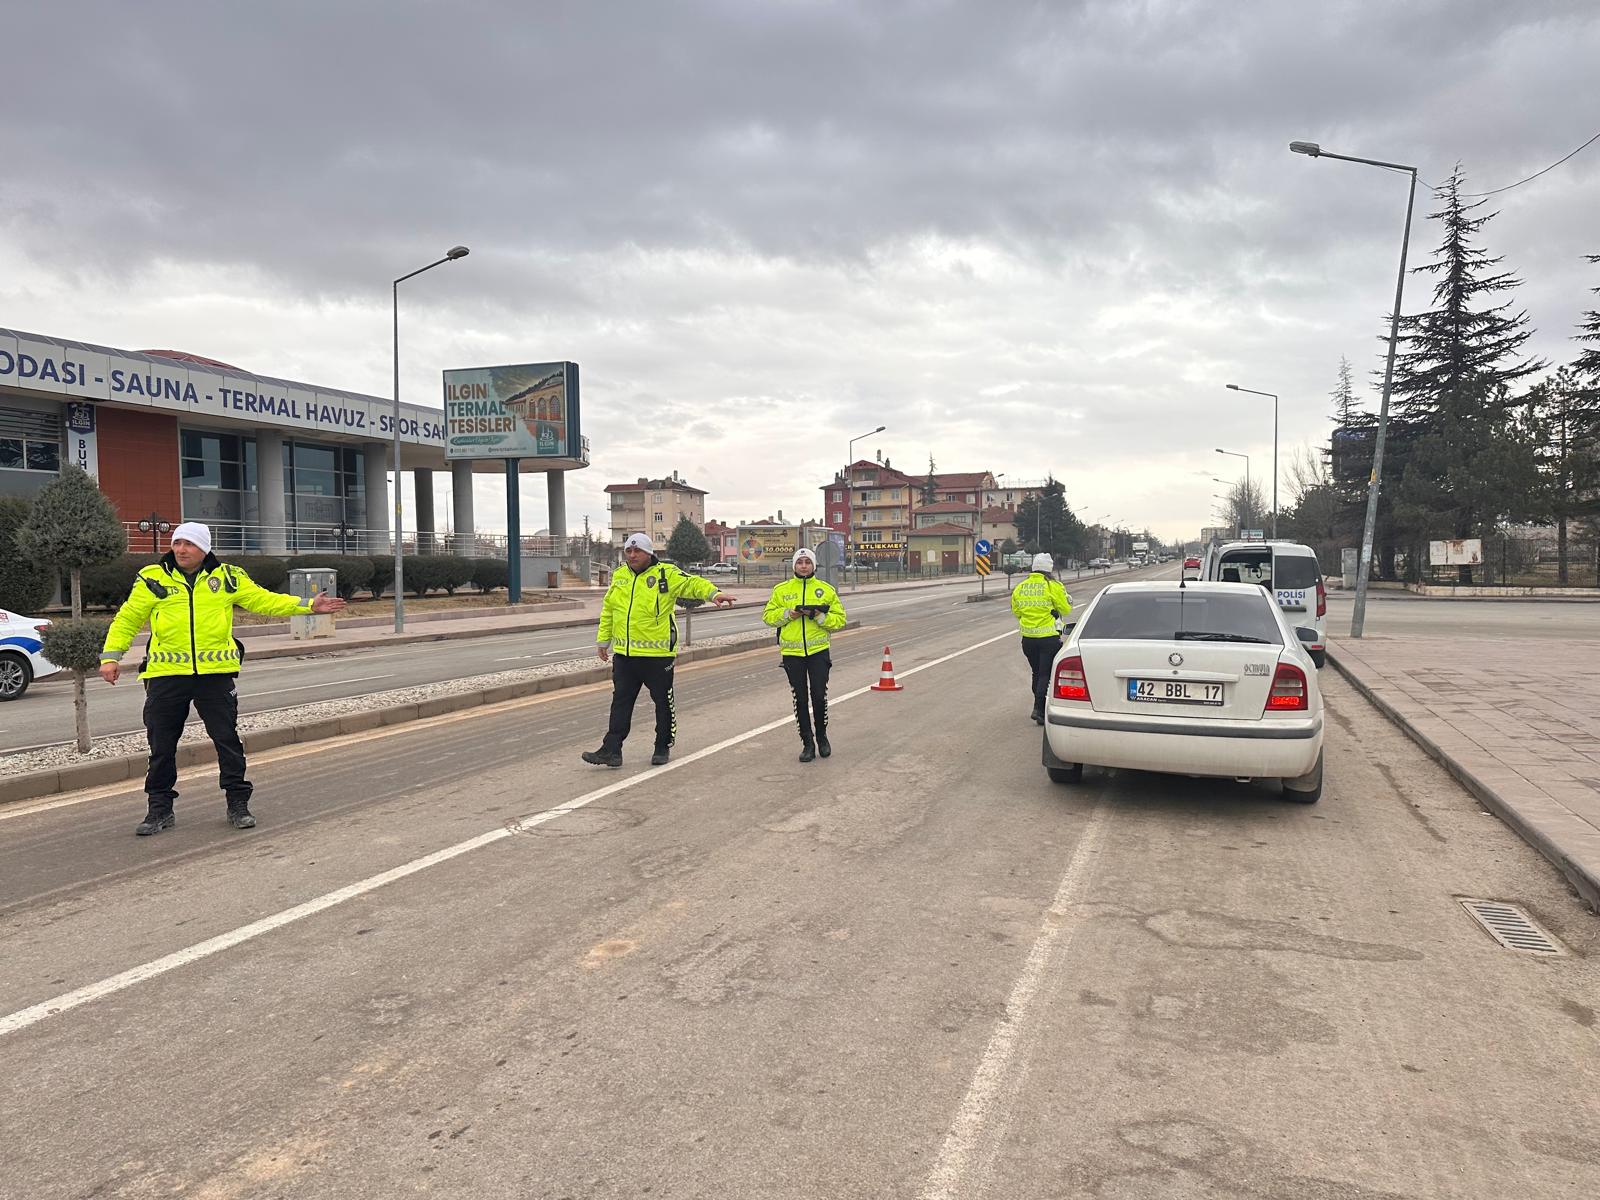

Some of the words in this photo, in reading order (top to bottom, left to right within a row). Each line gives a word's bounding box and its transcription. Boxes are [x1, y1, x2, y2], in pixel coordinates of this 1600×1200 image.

[111, 370, 199, 403] SAUNA
[219, 388, 300, 419] TERMAL
[306, 402, 365, 428] HAVUZ
[448, 383, 487, 400] ILGIN
[448, 401, 506, 417] TERMAL
[449, 415, 516, 434] TESİSLERİ
[1277, 590, 1306, 599] POLİSİ
[1138, 682, 1155, 696] 42
[1166, 683, 1191, 698] BBL
[1205, 685, 1220, 700] 17
